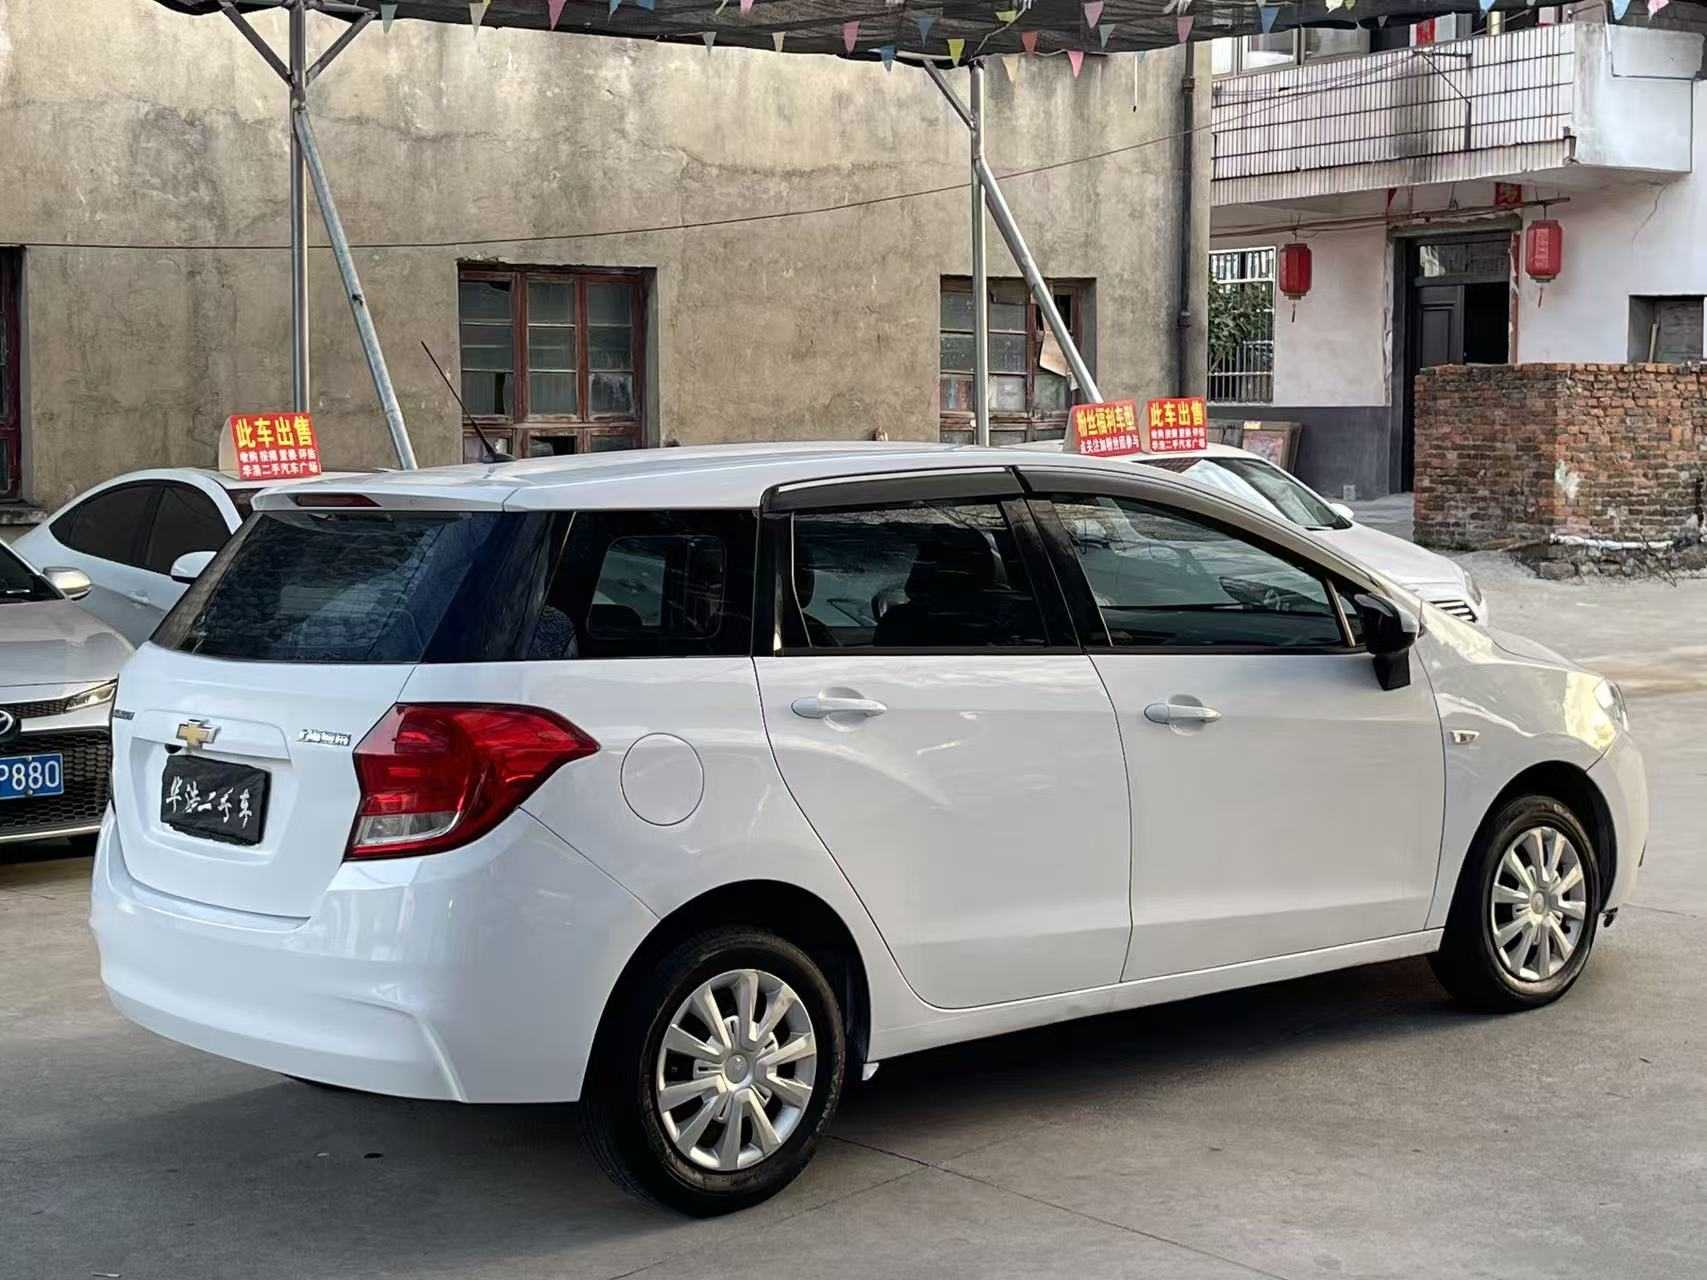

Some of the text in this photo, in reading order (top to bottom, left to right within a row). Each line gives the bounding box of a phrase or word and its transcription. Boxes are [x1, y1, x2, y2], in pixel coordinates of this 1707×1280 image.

[1150, 400, 1204, 428] 此车出售
[236, 416, 313, 448] 此车出售
